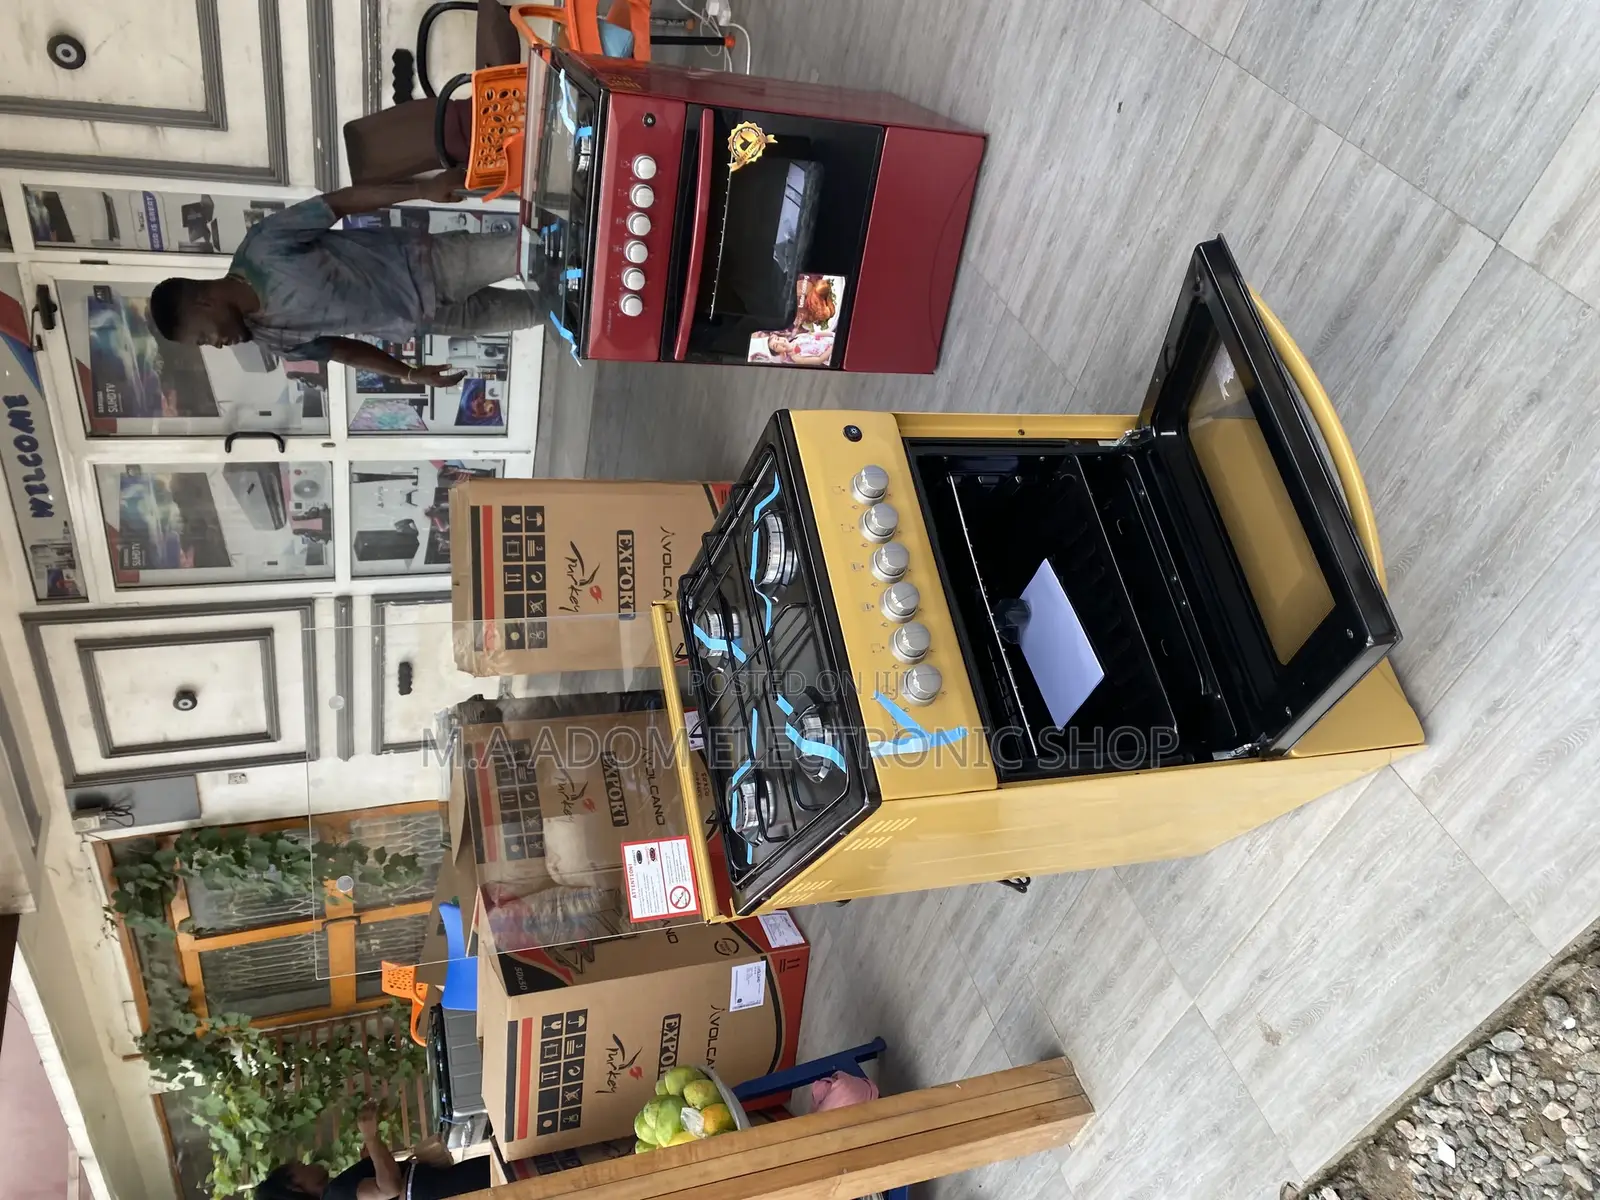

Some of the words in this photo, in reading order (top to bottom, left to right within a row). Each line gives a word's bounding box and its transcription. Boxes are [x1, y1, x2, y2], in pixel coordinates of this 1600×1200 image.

[3, 394, 54, 518] WELCOME
[559, 541, 584, 612] Turkey
[618, 534, 634, 617] EXPORT
[662, 541, 672, 623] VOLCAO
[602, 756, 628, 826] EXPORT
[595, 1034, 625, 1094] Turkey
[660, 1018, 679, 1075] EXPO
[706, 1016, 720, 1070] VOLCA
